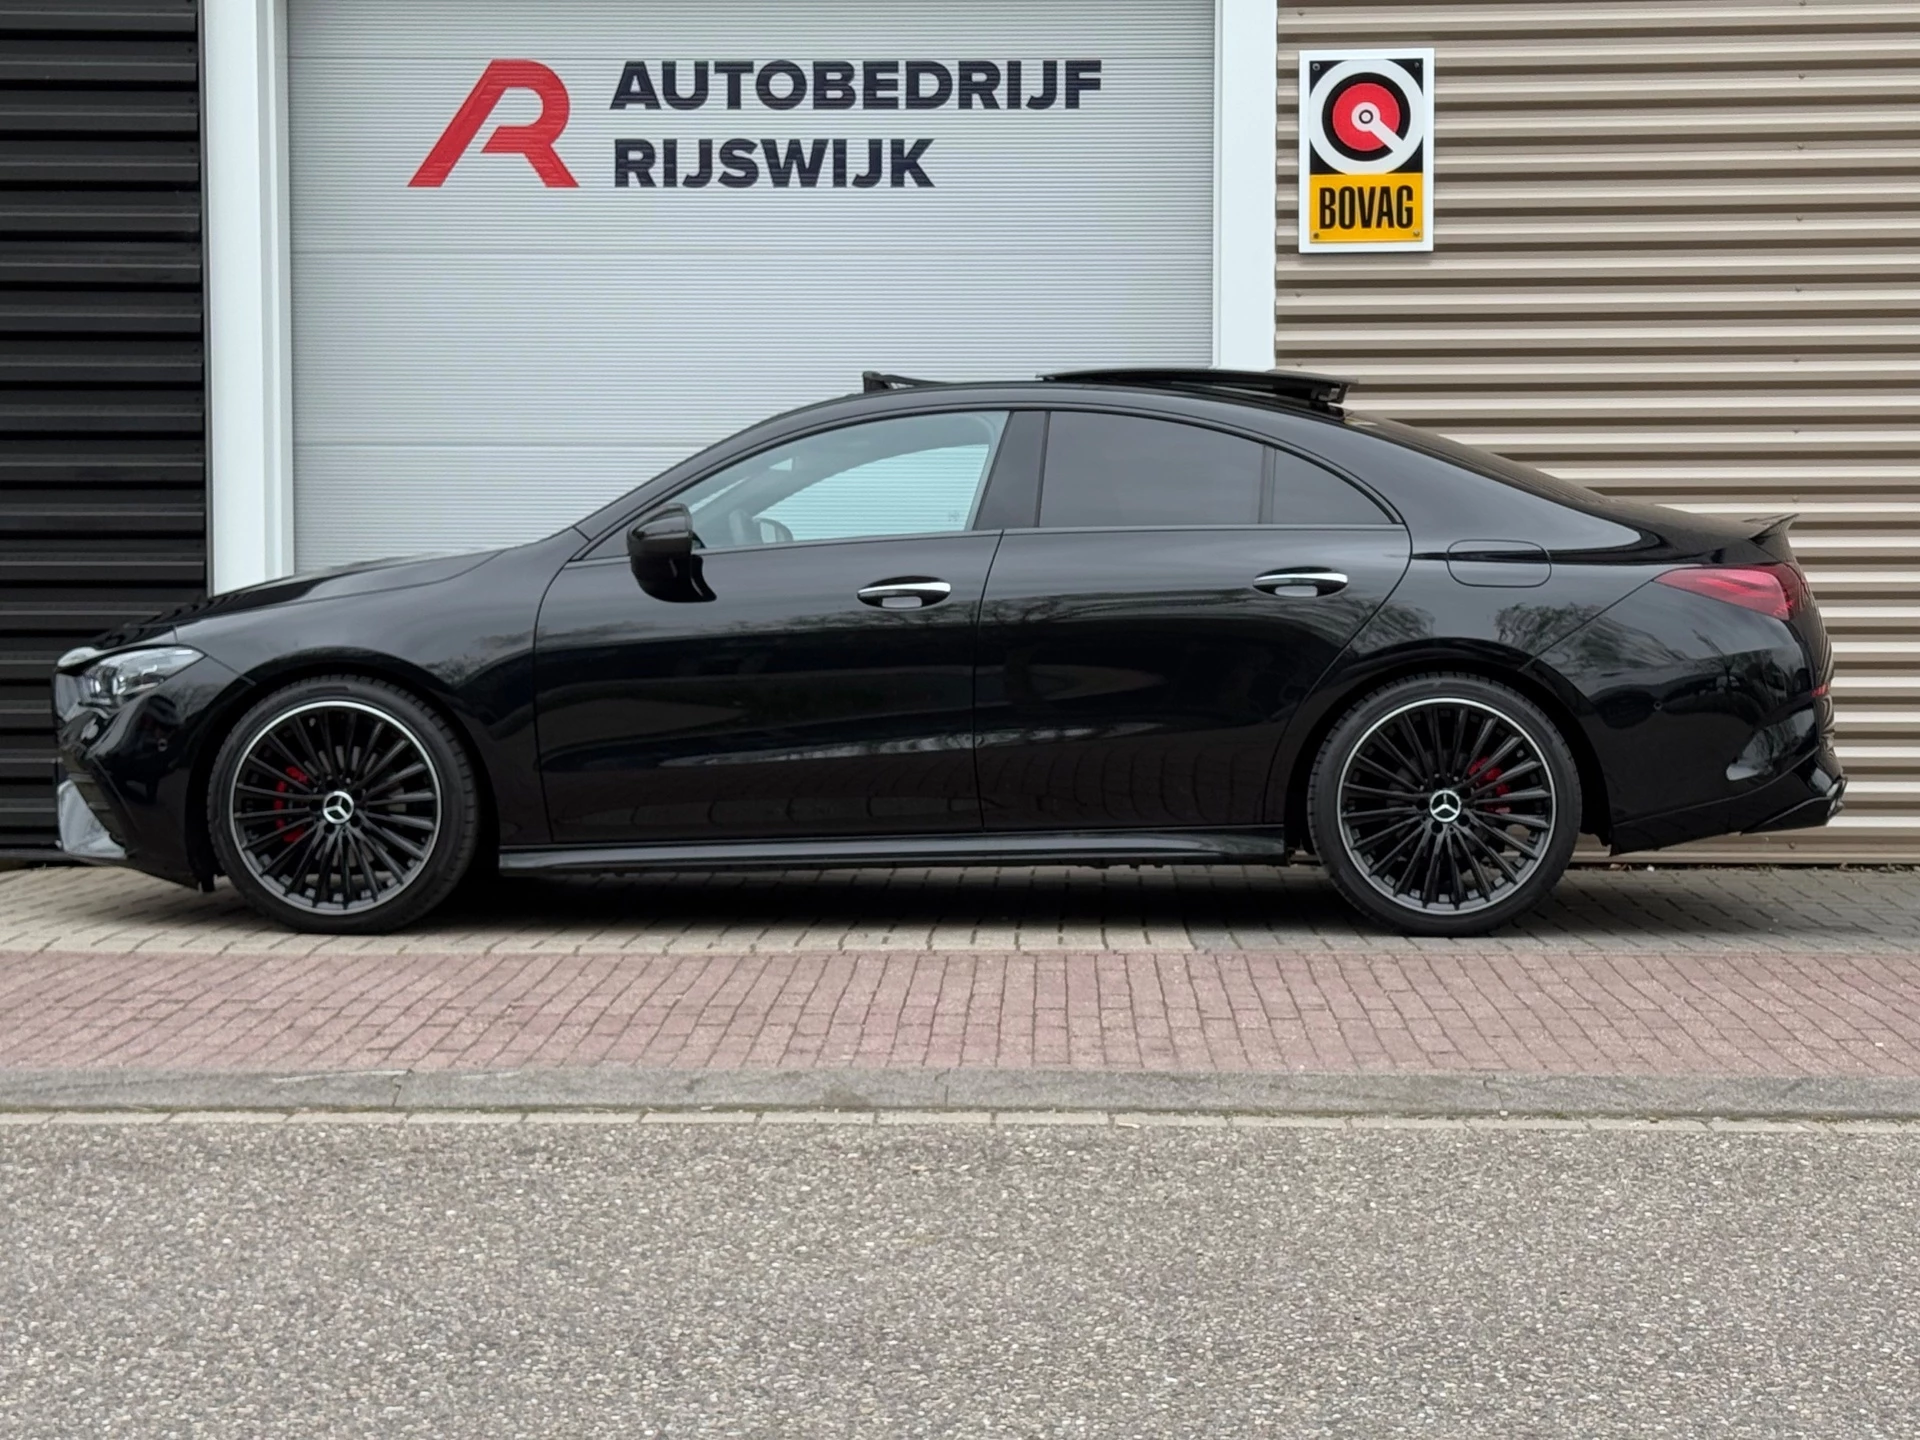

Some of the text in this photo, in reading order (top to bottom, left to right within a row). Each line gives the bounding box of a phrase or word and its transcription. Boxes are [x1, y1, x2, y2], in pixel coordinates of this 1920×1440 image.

[610, 60, 1102, 110] AUTOBEDRIJF
[614, 138, 935, 188] RIJSWIJK
[1319, 185, 1414, 230] BOVAG
